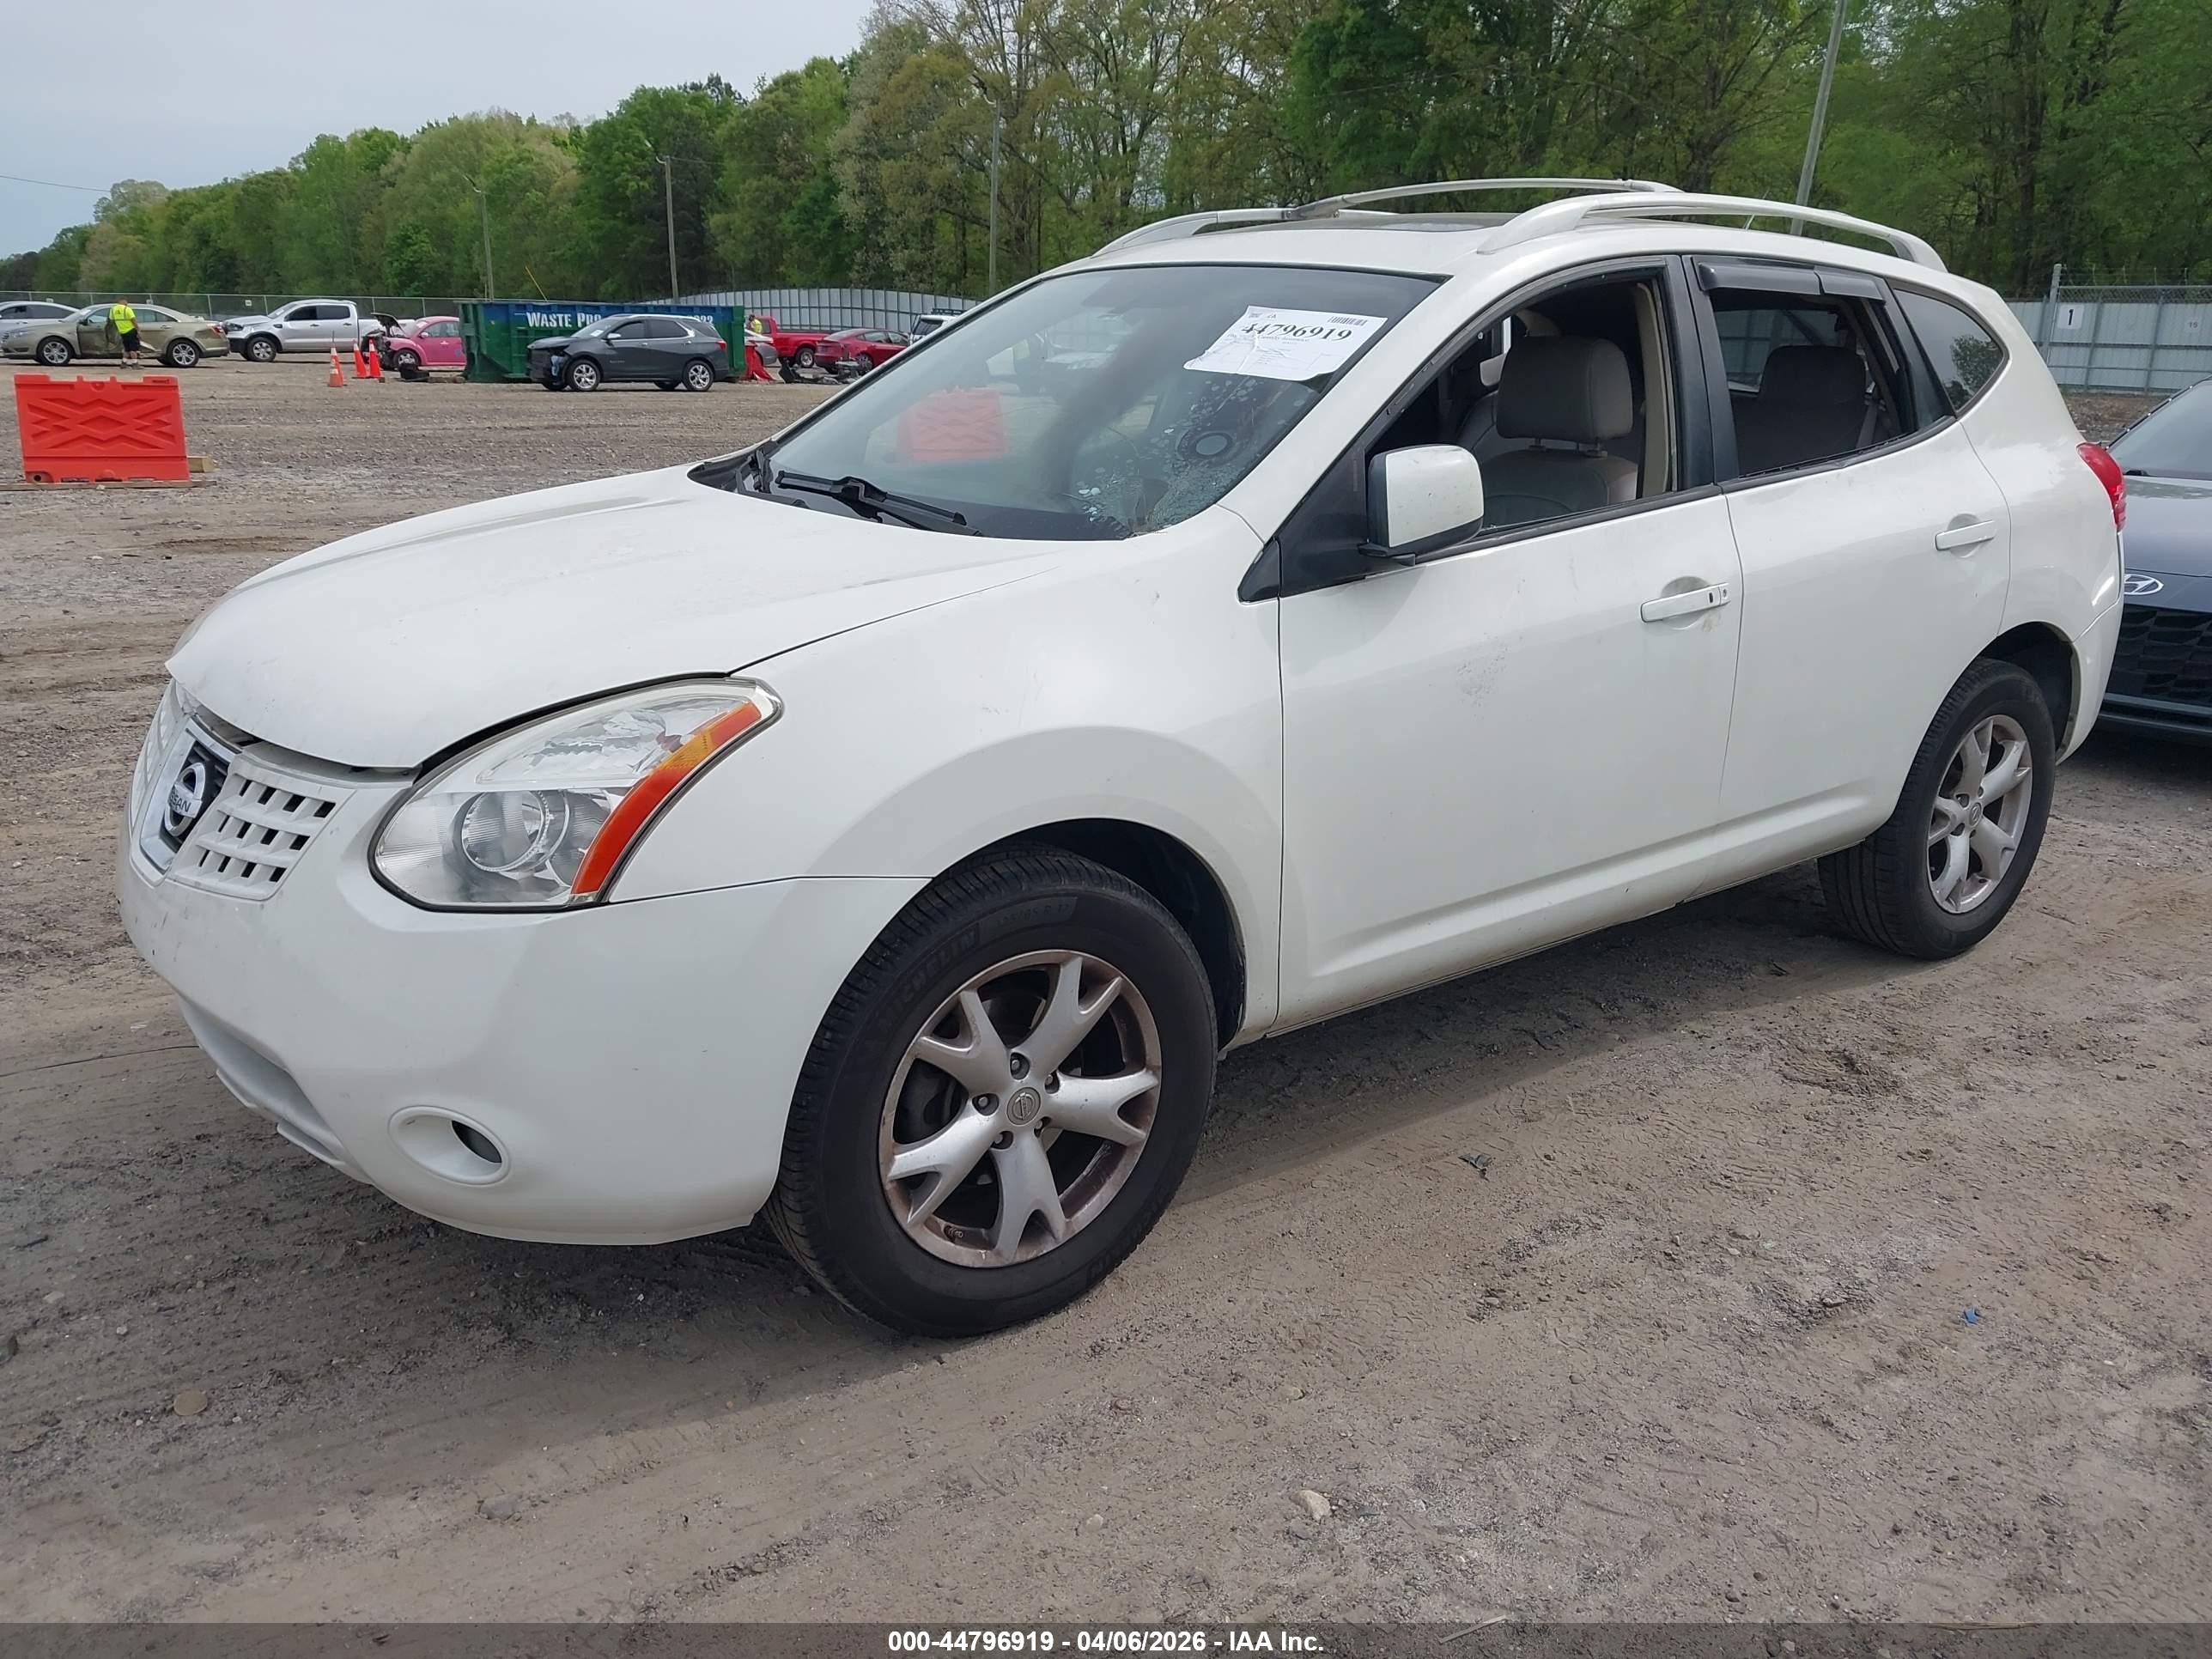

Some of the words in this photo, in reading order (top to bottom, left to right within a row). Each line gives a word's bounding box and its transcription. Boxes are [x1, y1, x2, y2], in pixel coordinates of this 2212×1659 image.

[526, 312, 572, 328] WASTE
[2068, 308, 2075, 326] 1
[1241, 322, 1353, 342] 44796919
